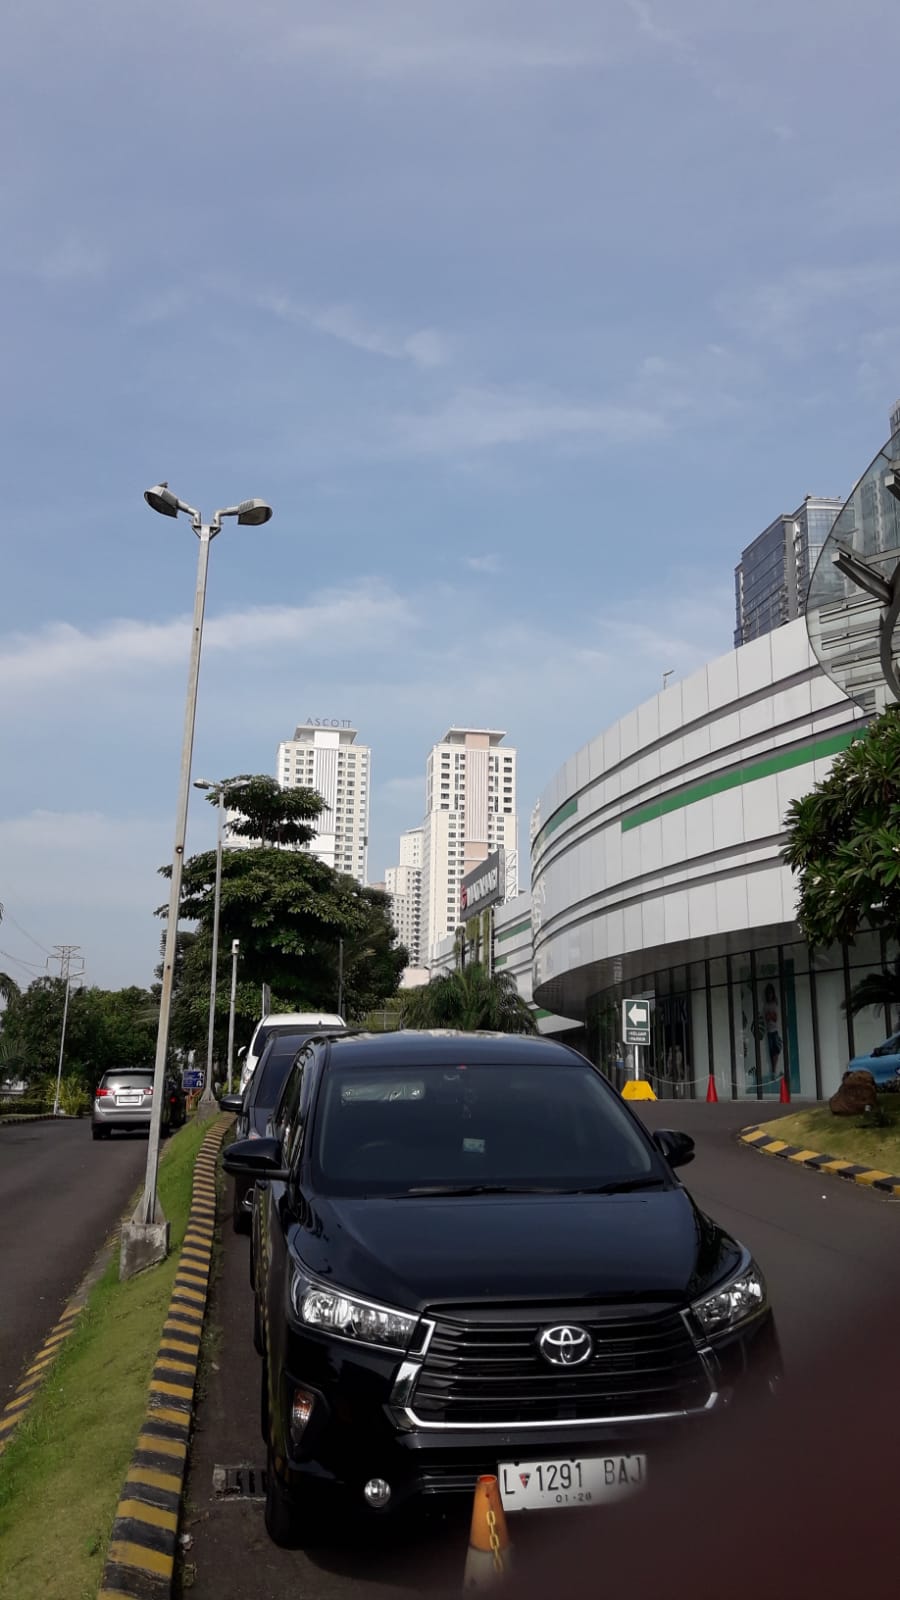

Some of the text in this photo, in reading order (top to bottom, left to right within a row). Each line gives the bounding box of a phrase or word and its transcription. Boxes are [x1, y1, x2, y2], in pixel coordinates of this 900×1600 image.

[306, 717, 352, 728] ASCOTT
[503, 1457, 641, 1494] L 1291 BAJ
